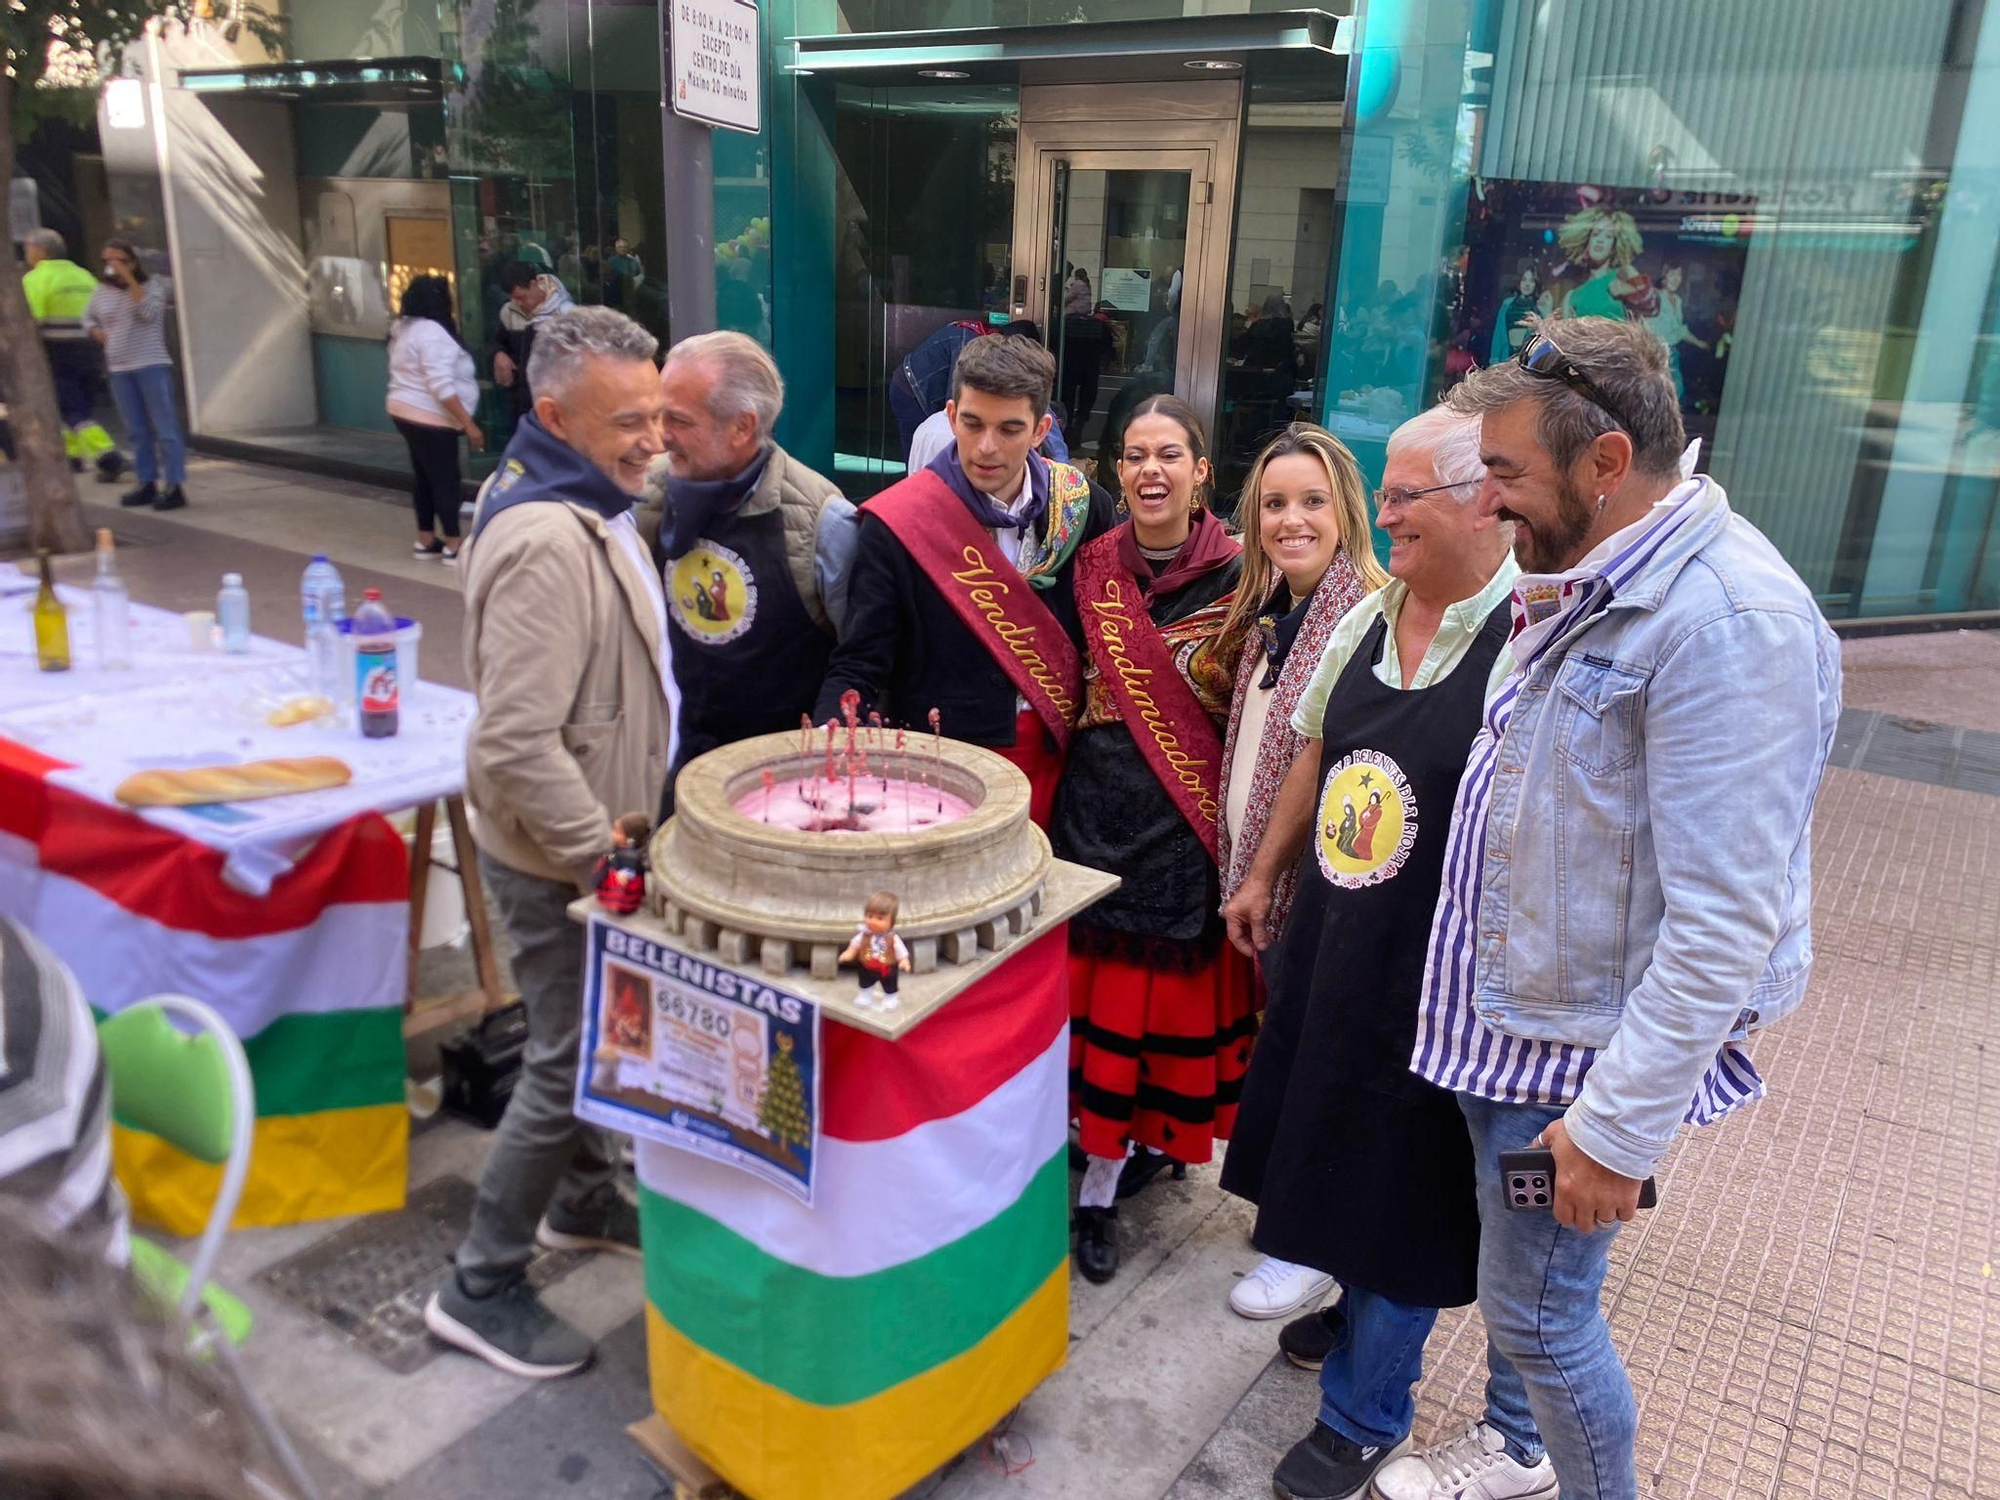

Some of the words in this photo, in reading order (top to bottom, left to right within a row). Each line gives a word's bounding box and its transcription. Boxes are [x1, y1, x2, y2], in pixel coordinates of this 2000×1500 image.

[682, 4, 690, 22] DE
[692, 9, 707, 29] 8:00
[709, 15, 716, 32] H.
[718, 19, 723, 35] A
[725, 21, 743, 41] 21:00
[702, 33, 731, 57] EXCEPTO
[692, 51, 718, 73] CENTRO
[719, 60, 728, 77] DE
[730, 60, 742, 81] DÍA
[687, 70, 710, 92] Máximo
[712, 77, 721, 95] 20
[722, 82, 748, 101] minutos
[1091, 579, 1217, 823] Vendimiadora
[1353, 750, 1406, 786] BELENISTAS
[1390, 822, 1419, 868] RIOJA
[605, 928, 802, 1025] BELENISTAS
